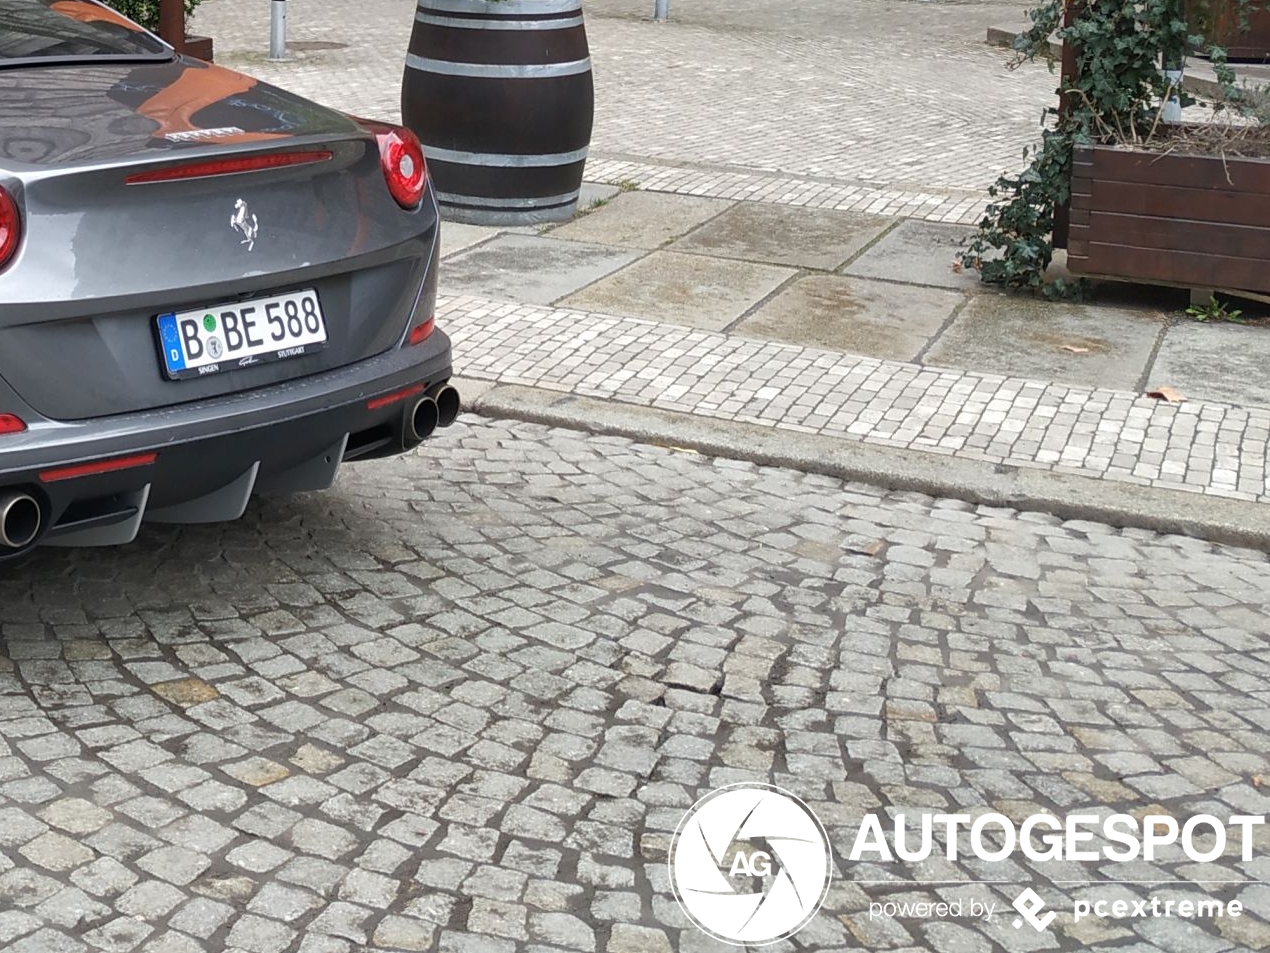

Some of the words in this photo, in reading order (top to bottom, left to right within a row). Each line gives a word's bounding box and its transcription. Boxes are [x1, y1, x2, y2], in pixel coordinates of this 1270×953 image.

[180, 319, 204, 361] B
[220, 307, 264, 352] BE
[265, 296, 320, 342] 588
[170, 349, 179, 362] D
[198, 364, 219, 375] SINGEN
[278, 346, 305, 358] STUTTGART
